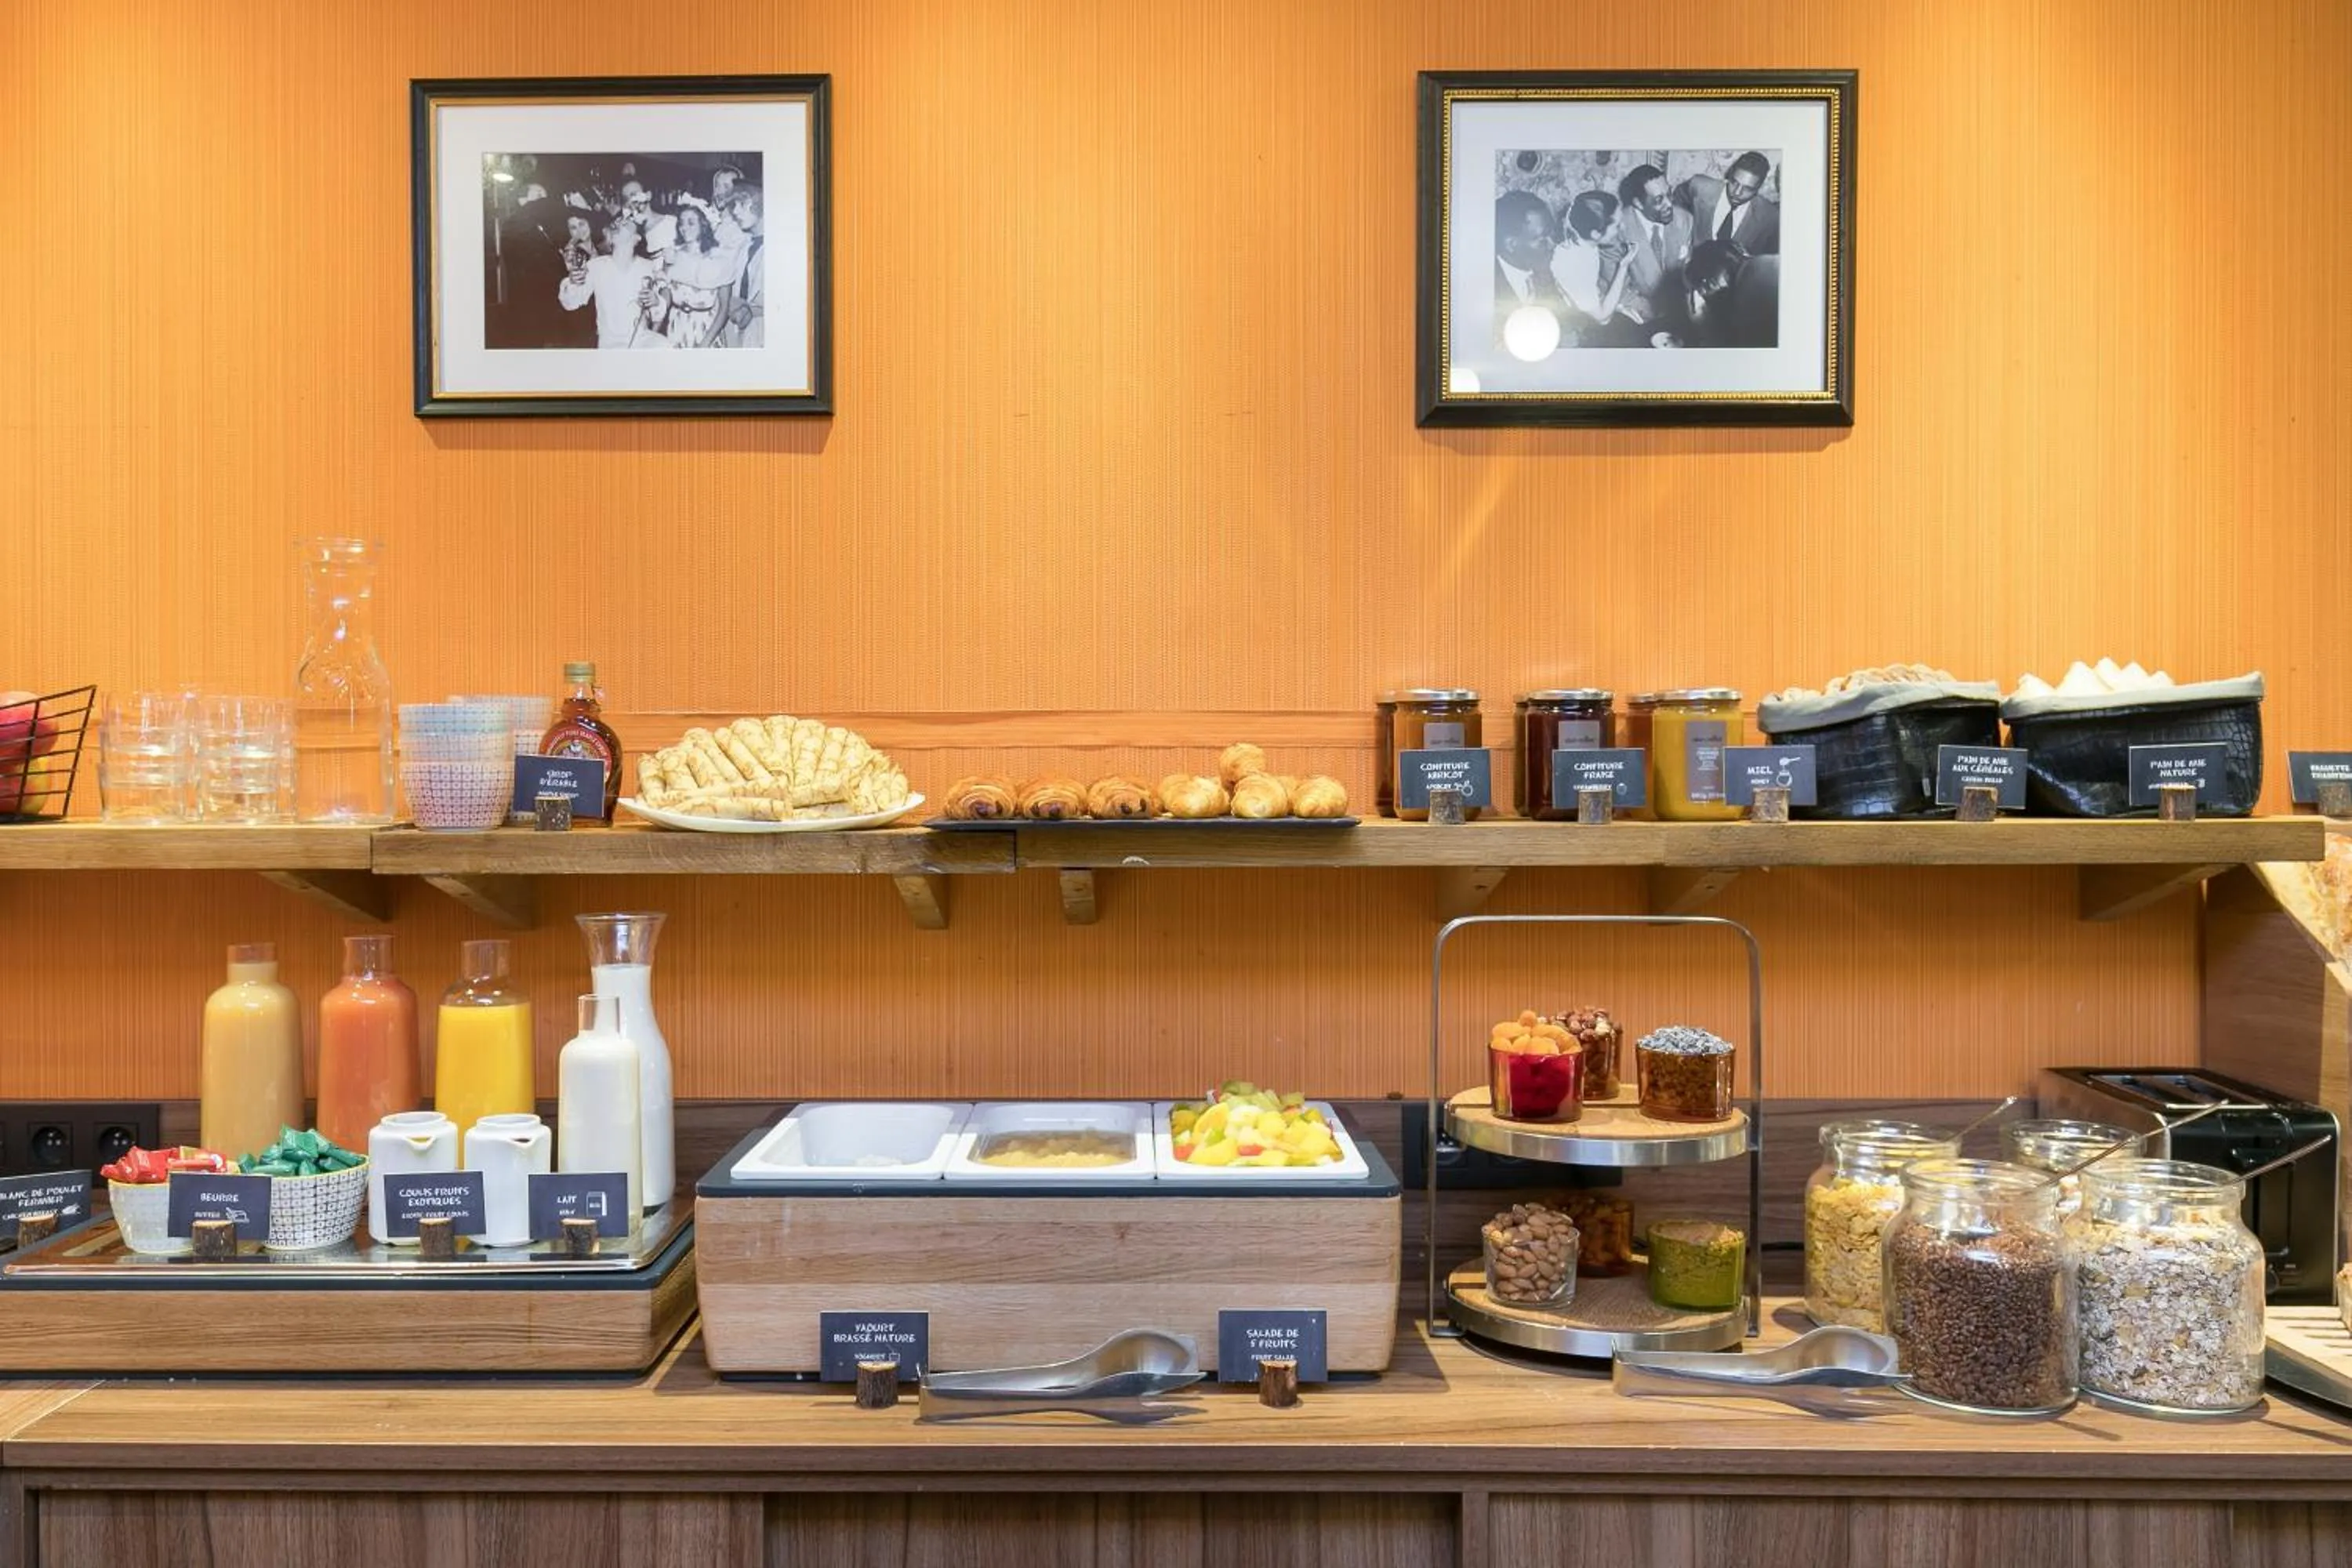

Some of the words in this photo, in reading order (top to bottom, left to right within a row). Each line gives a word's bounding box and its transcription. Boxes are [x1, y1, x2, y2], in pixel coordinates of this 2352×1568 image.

[1420, 761, 1471, 771] CONFITURE
[1573, 762, 1624, 771] CONFITURE
[1747, 765, 1773, 775] MIEL
[2159, 768, 2198, 778] NATURE
[31, 1189, 44, 1197] DE
[46, 1185, 84, 1196] POULET
[434, 1186, 470, 1196] FRUITS
[200, 1192, 239, 1203] BEURRE
[408, 1196, 462, 1207] EXOTIQUES
[557, 1194, 578, 1204] LAIT
[855, 1323, 895, 1333] YAOURT
[874, 1334, 916, 1343] NATURE
[1246, 1329, 1283, 1338] SALADE
[1286, 1329, 1300, 1338] DE
[1258, 1338, 1299, 1348] FRUITS
